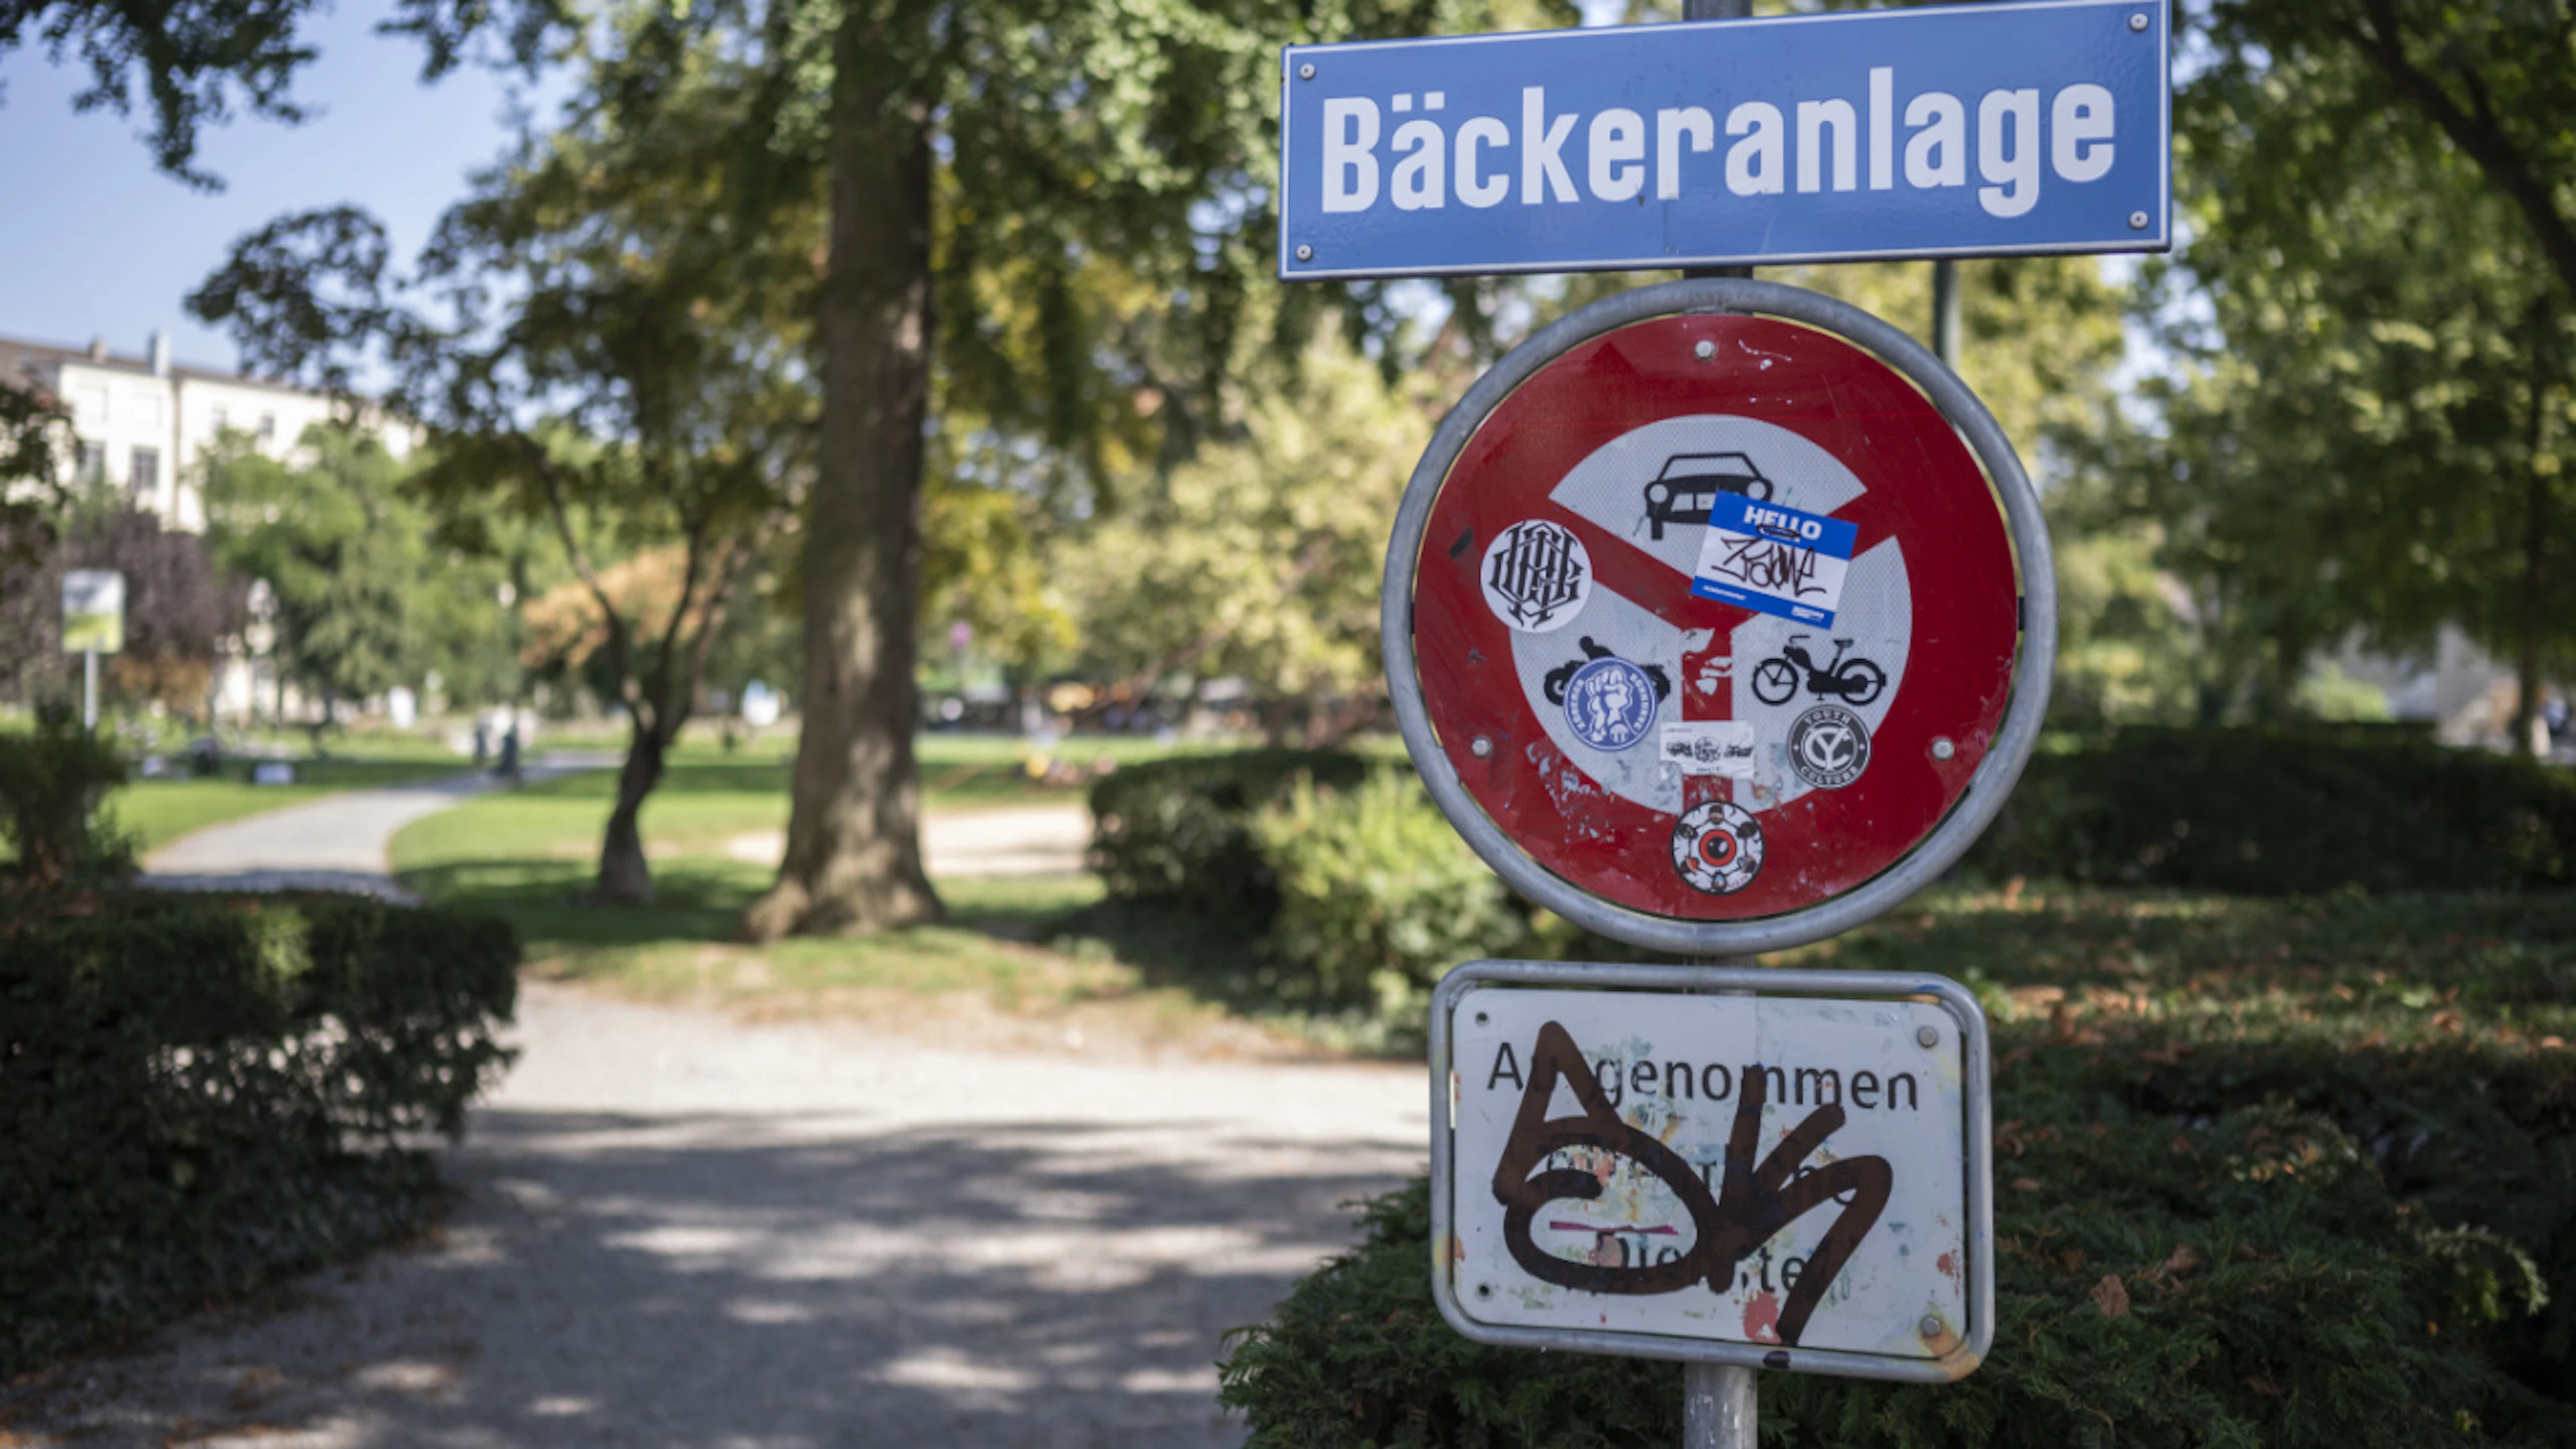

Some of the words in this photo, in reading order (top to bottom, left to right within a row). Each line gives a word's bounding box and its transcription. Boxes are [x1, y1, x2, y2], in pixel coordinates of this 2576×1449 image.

[1322, 66, 2116, 219] Bäckeranlage
[1743, 505, 1822, 540] HELLO
[1804, 710, 1850, 725] YOUTH
[1800, 765, 1858, 785] CULTURE
[1487, 1042, 1917, 1112] Agenommen
